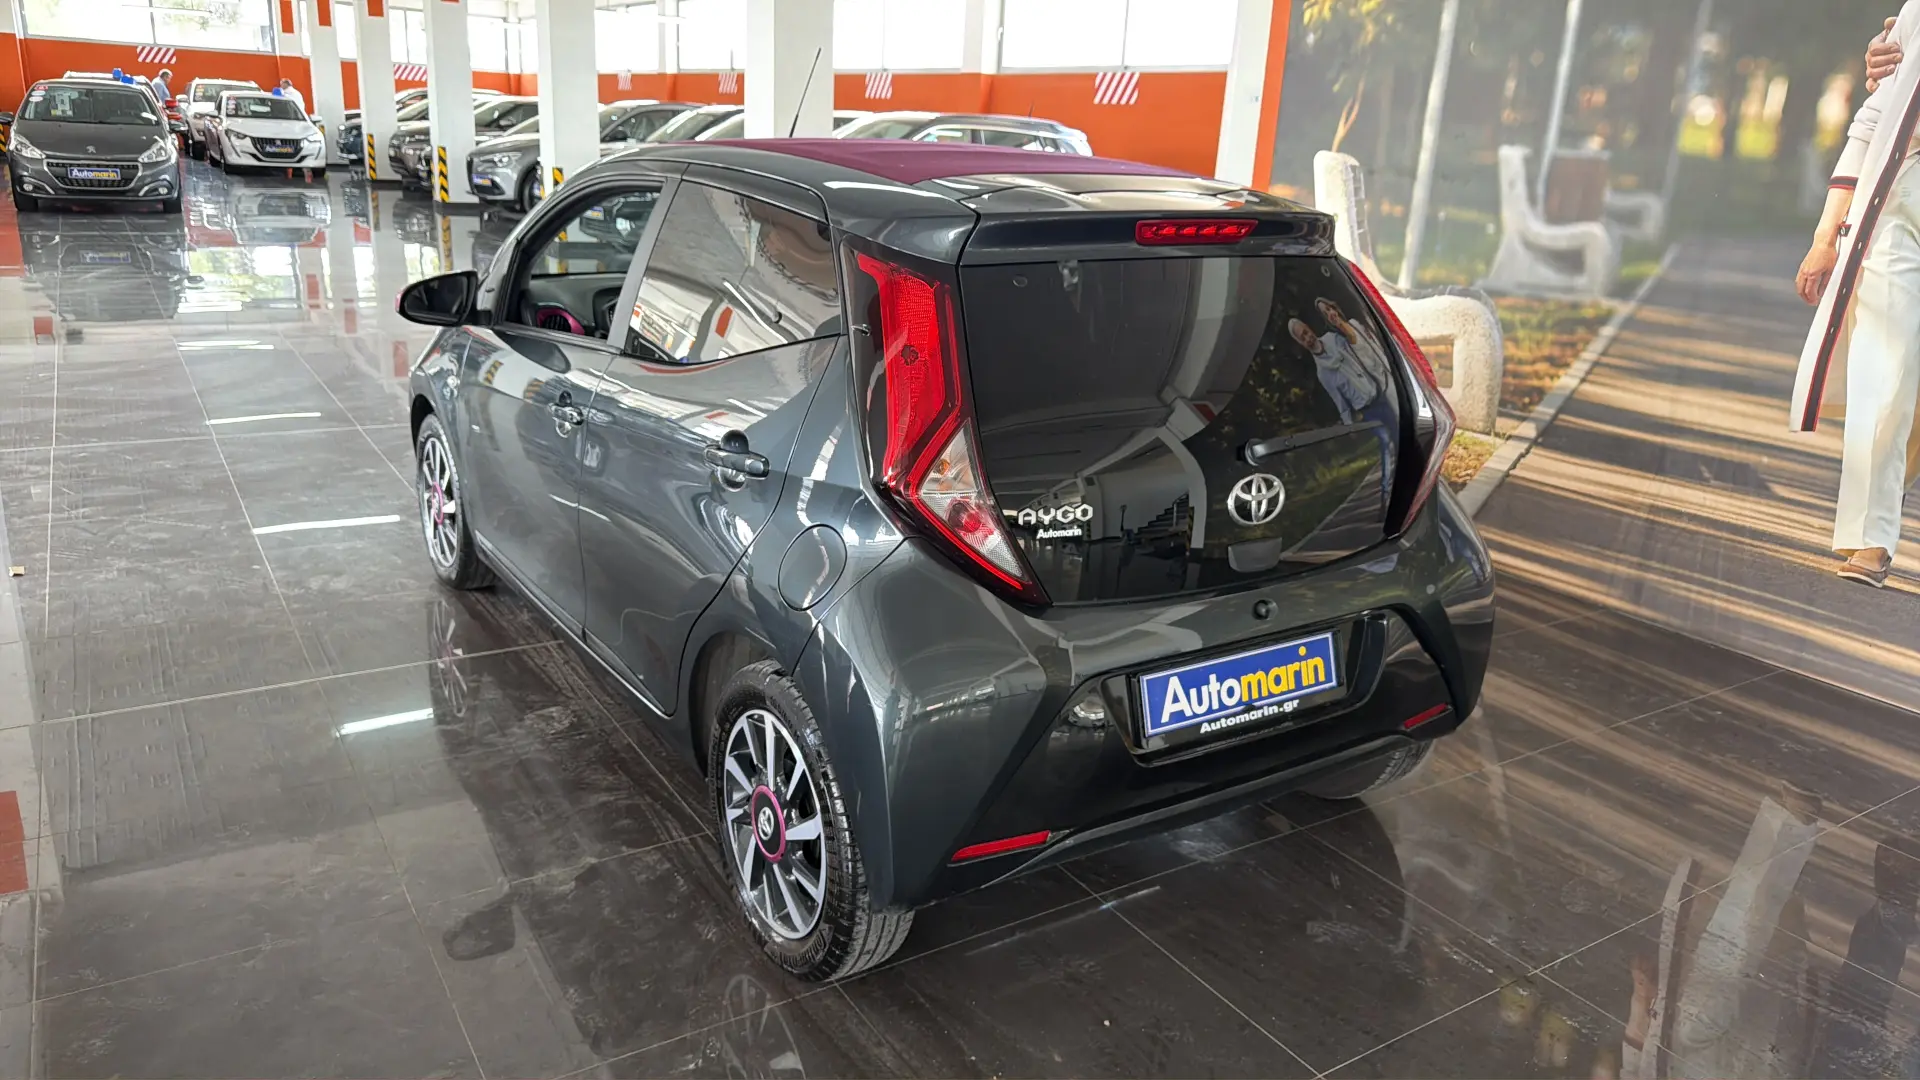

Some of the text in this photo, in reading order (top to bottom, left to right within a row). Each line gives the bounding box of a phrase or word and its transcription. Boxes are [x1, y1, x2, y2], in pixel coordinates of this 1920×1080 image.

[71, 168, 118, 178] Automarin
[1018, 503, 1093, 526] AYGO
[1036, 525, 1082, 539] Automarin
[1160, 645, 1326, 723] Automarin
[1200, 699, 1300, 733] Automarin.gr
